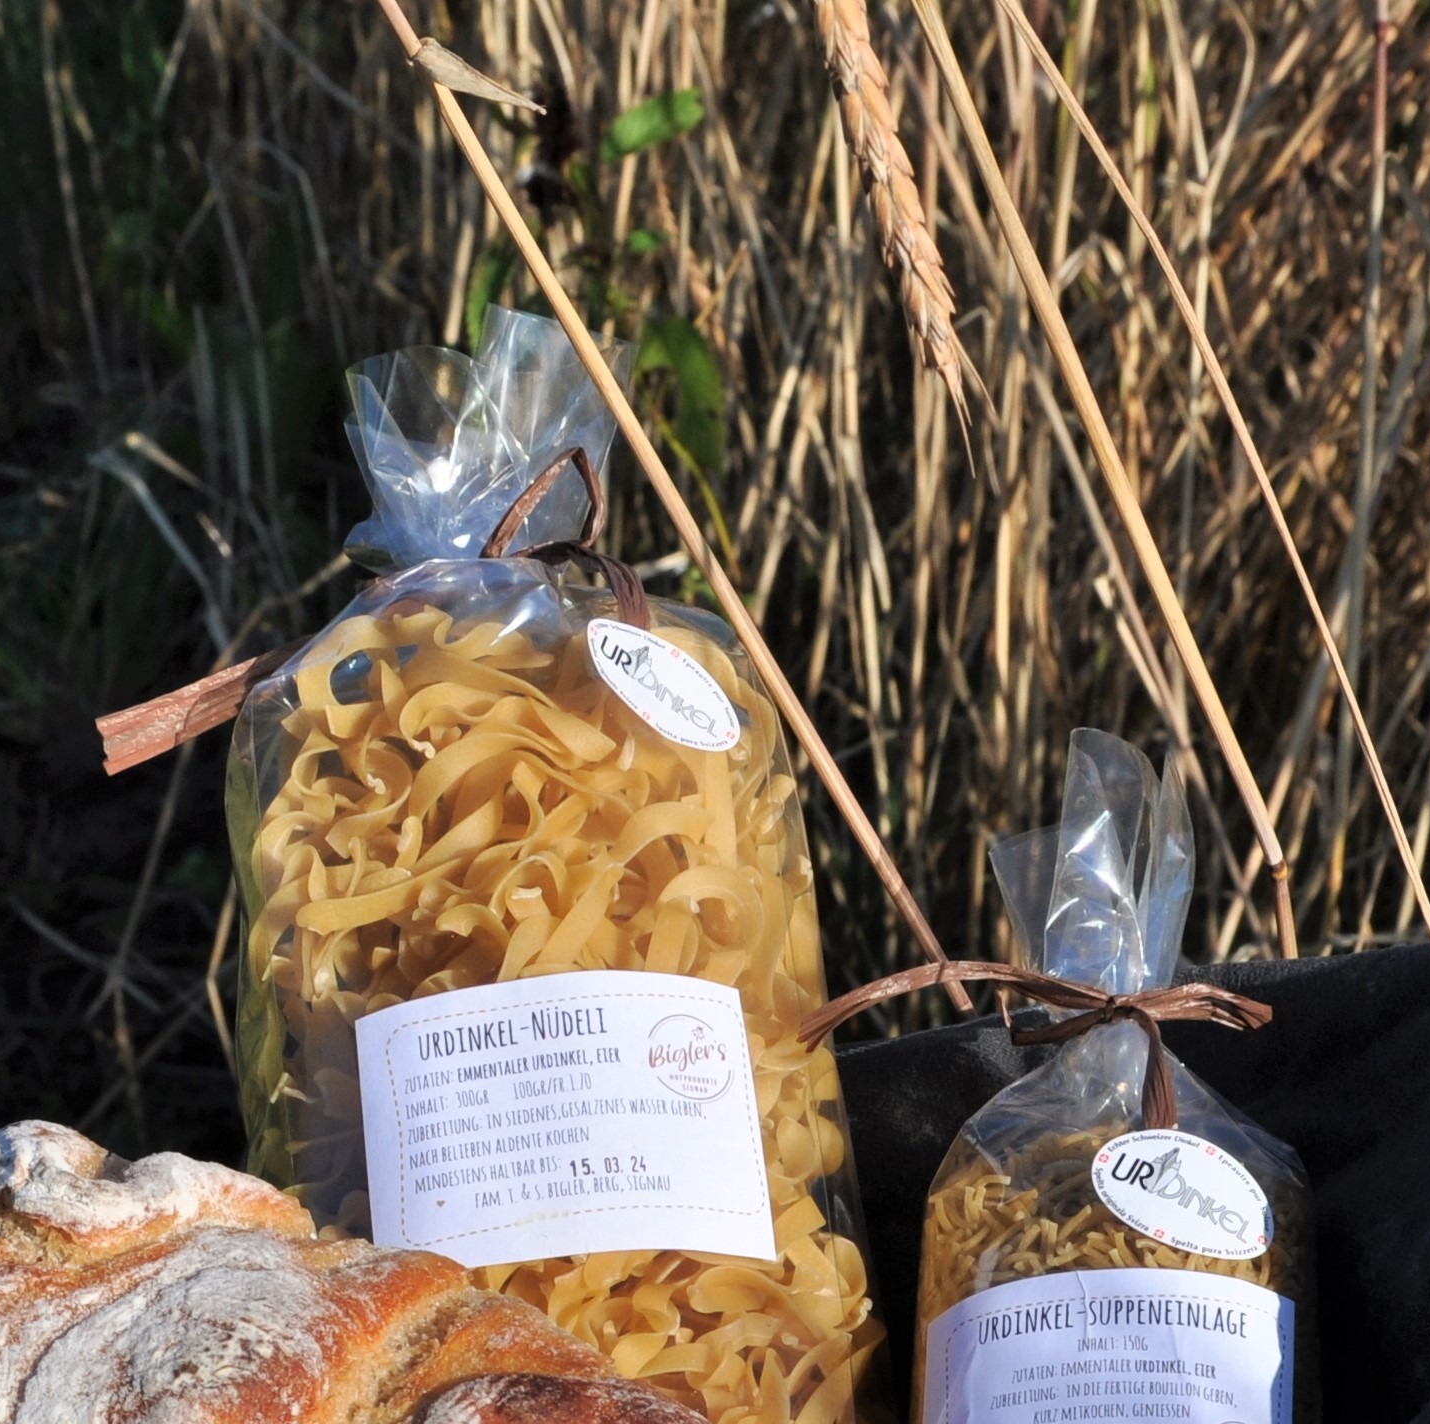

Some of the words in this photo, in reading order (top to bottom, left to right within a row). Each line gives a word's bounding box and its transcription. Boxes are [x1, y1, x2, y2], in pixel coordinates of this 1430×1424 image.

[418, 1006, 607, 1061] URDINKEL-NÜDELI
[404, 1070, 454, 1095] ZUTATEN:
[457, 1057, 530, 1083] EMMENTALER
[532, 1049, 593, 1071] URDINKEL,
[597, 1047, 622, 1064] EIER
[405, 1096, 450, 1120] INHALT:
[455, 1089, 490, 1109] 300GR
[408, 1115, 483, 1145] ZUBEREITUNG:
[486, 1113, 502, 1129] IN
[629, 1098, 669, 1115] WASSER
[671, 1100, 707, 1120] GEBEN,
[409, 1148, 439, 1170] NACH
[441, 1140, 491, 1162] BELIEBEN
[495, 1131, 543, 1154] ALDENTE
[546, 1126, 590, 1148] KOCHEN
[414, 1165, 487, 1194] MINDESTENS
[490, 1158, 536, 1181] HALTBAR
[540, 1155, 562, 1173] BIS:
[630, 1155, 647, 1172] 24
[474, 1190, 504, 1209] FAM.
[521, 1182, 531, 1200] &
[547, 1178, 591, 1199] BIGLER,
[593, 1175, 625, 1193] BERG,
[627, 1174, 671, 1192] SIGNAU
[978, 1299, 1248, 1345] URDINKEL-SUPPENEINLAGE
[1077, 1336, 1120, 1353] INHALT:
[1123, 1335, 1149, 1351] 150G
[1011, 1364, 1058, 1384] ZUTATEN:
[1061, 1358, 1131, 1377] EMMENTALER
[1195, 1362, 1216, 1380] EIER
[990, 1386, 1060, 1410] ZUBEREITUNG:
[1067, 1384, 1081, 1398] IN
[1083, 1382, 1102, 1396] DIE
[1104, 1381, 1145, 1395] FERTIGE
[1149, 1381, 1201, 1398] BOUILLON
[1033, 1407, 1058, 1424] KURZ
[1061, 1403, 1129, 1422] MITKOCHEN,
[1132, 1402, 1191, 1418] GENIESSEN
